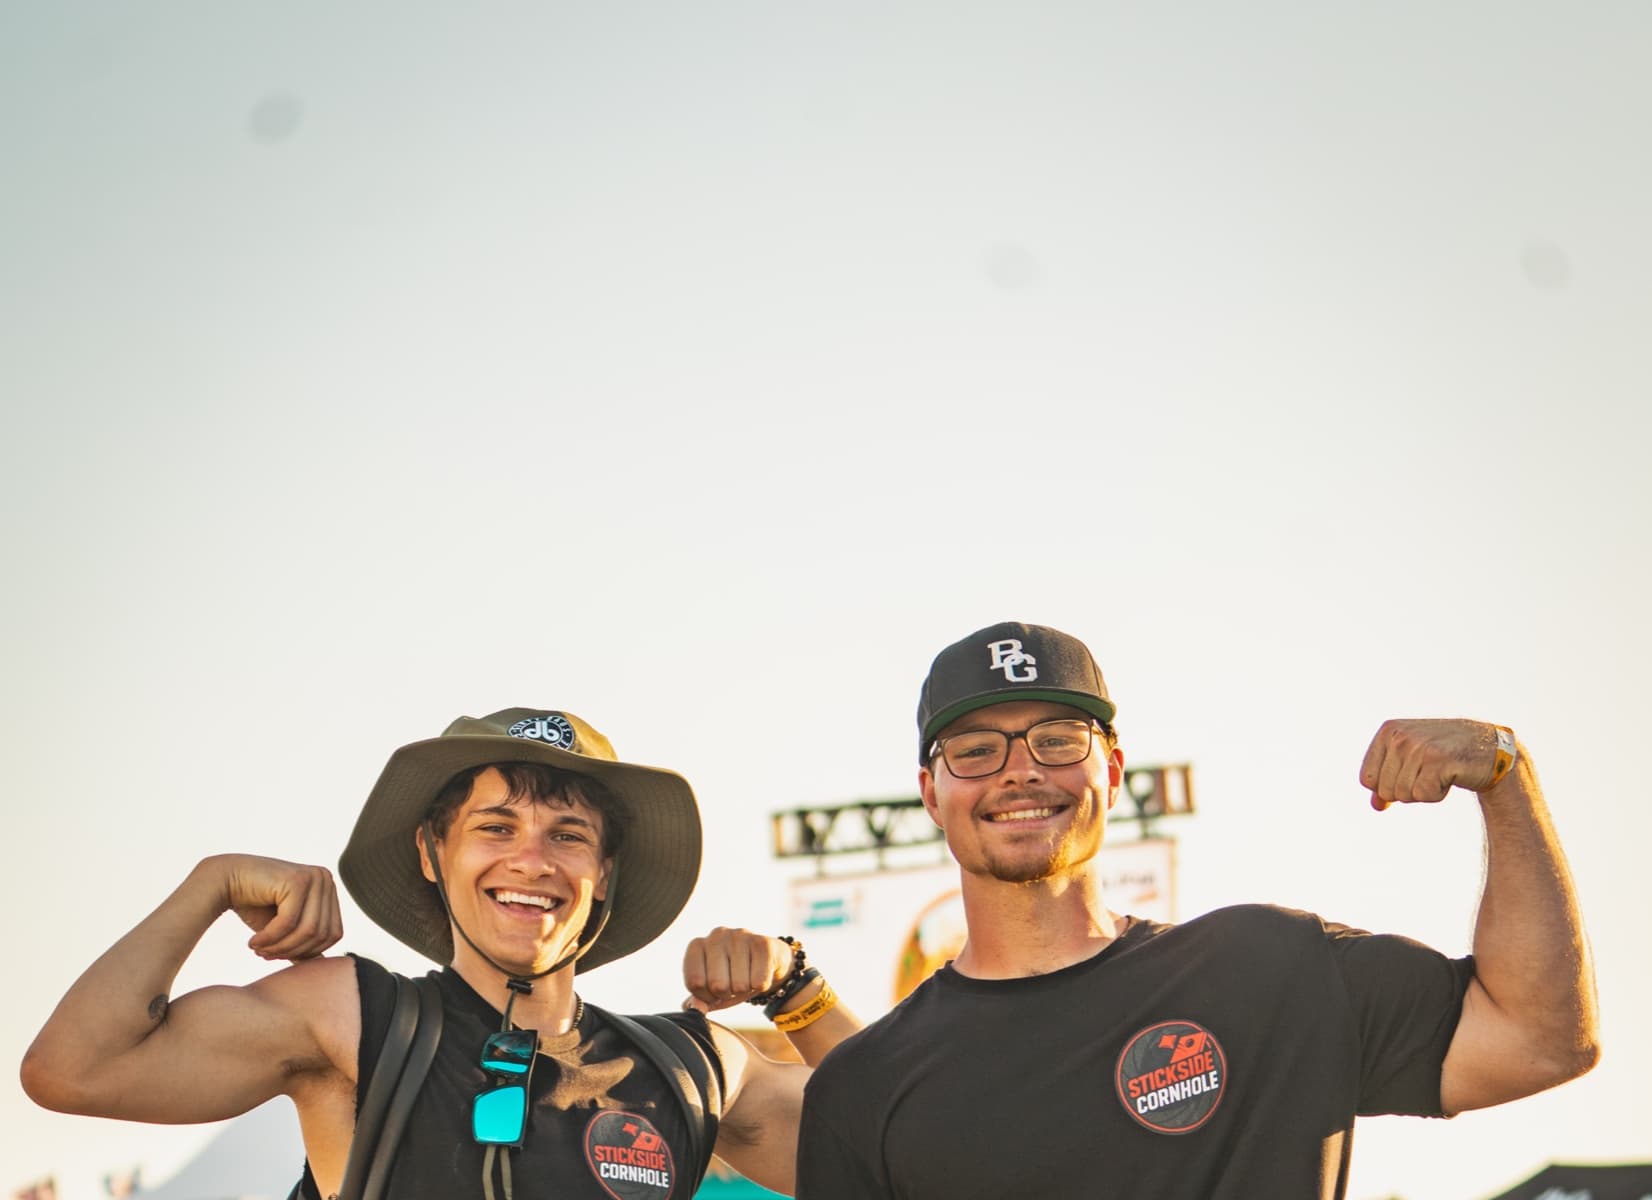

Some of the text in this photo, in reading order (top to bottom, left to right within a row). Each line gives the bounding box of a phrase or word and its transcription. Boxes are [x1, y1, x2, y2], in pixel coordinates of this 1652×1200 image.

[1127, 1049, 1215, 1098] STICKSIDE
[1136, 1070, 1219, 1114] CORNHOLE
[594, 1145, 666, 1170] STICKSIDE
[600, 1162, 669, 1188] CORNHOLE
